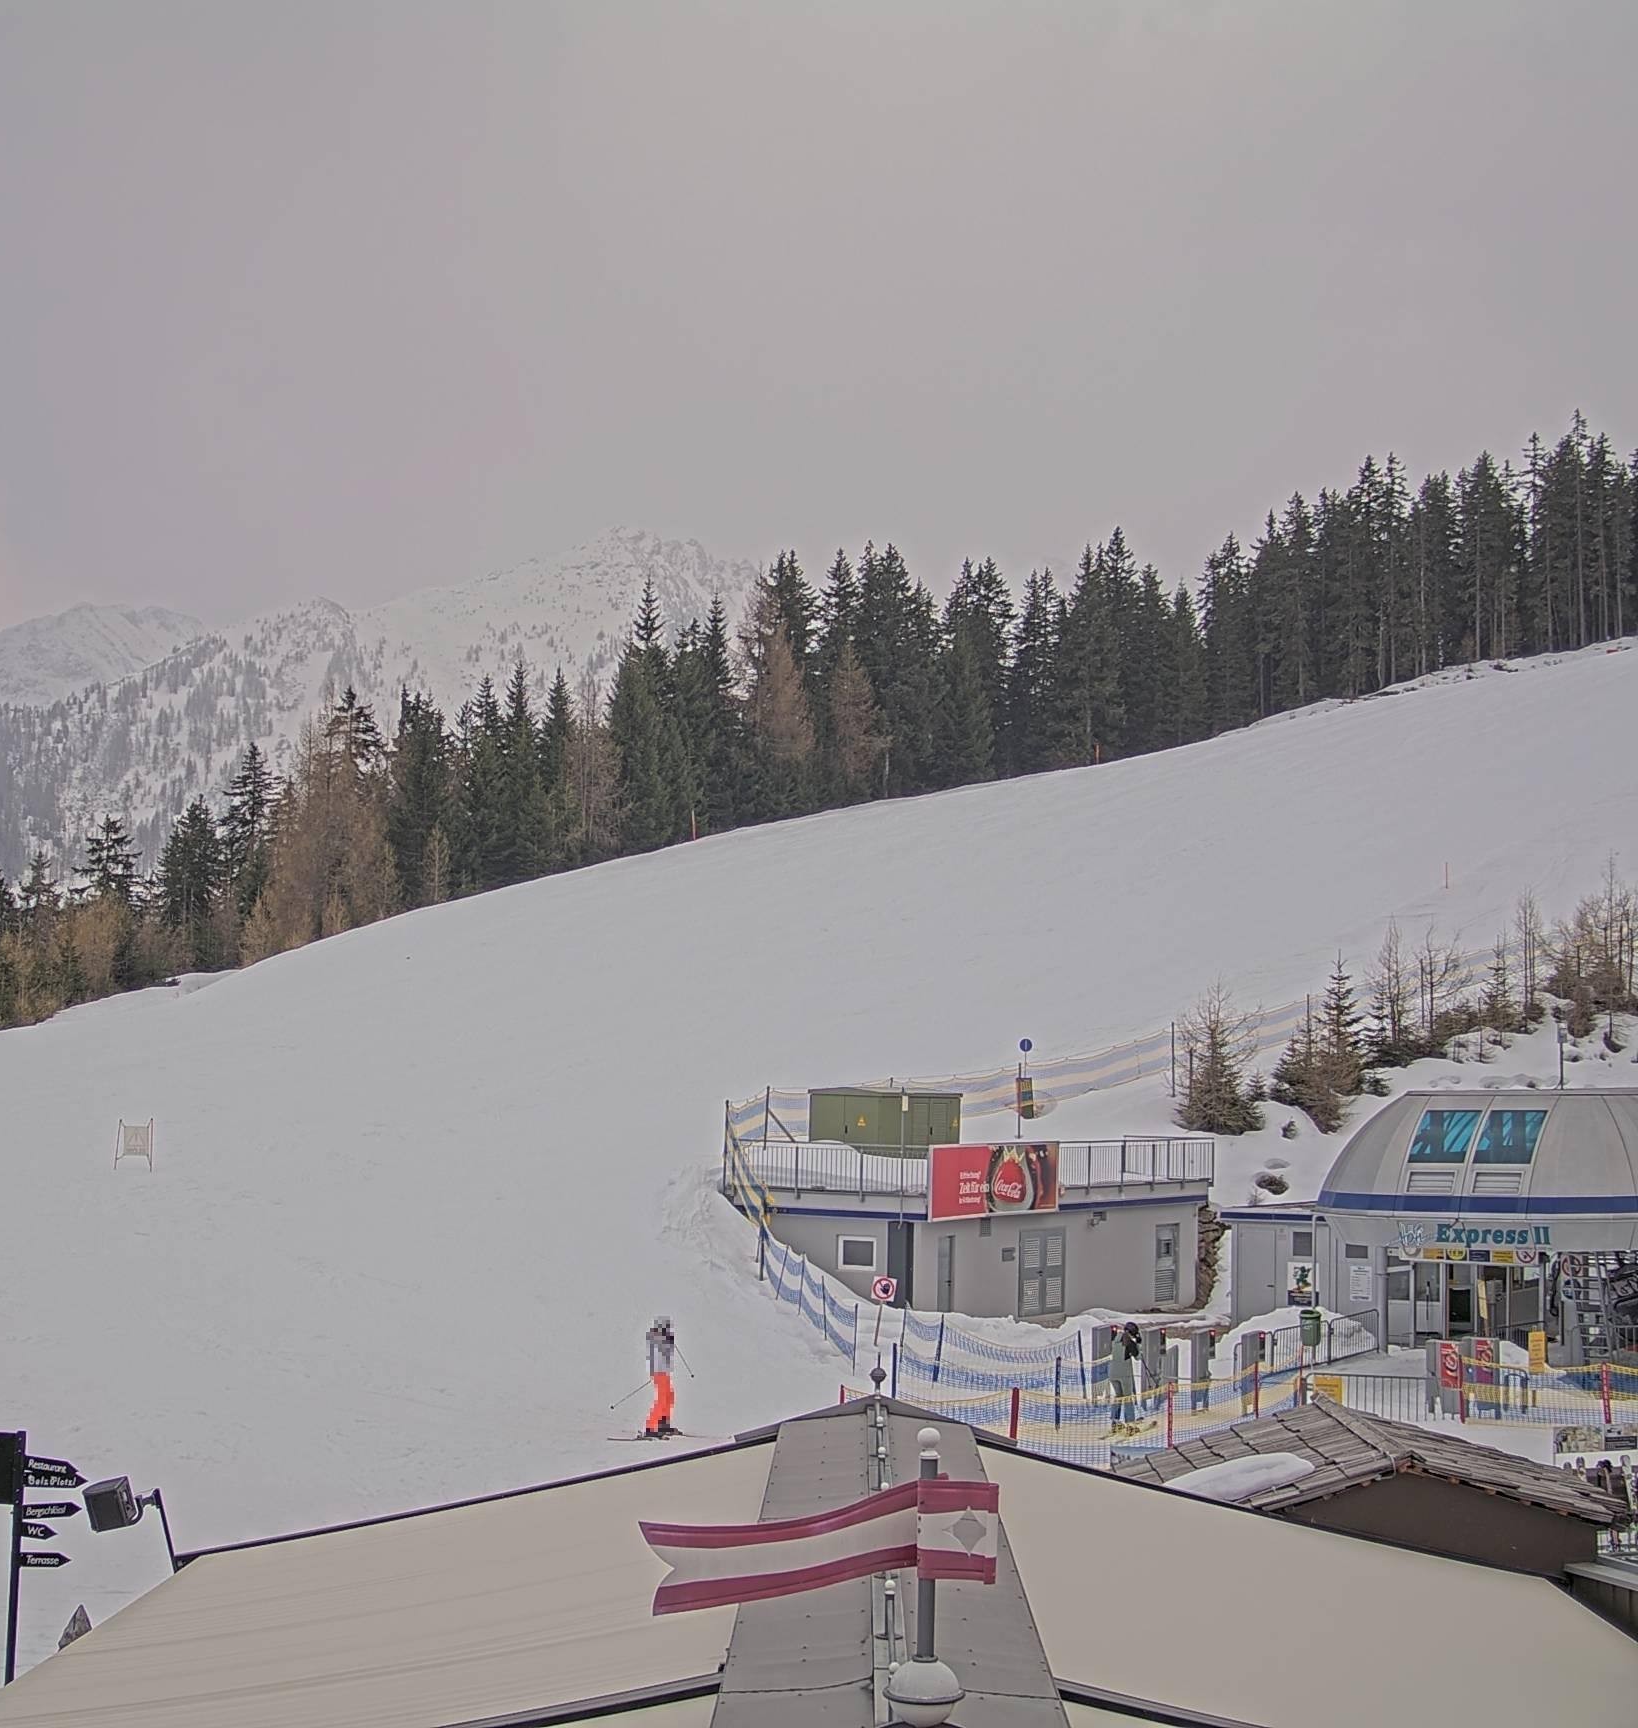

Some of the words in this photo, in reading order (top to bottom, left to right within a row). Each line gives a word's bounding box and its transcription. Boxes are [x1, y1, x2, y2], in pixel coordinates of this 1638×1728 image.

[1436, 1223, 1529, 1248] Express
[1533, 1226, 1551, 1245] II
[27, 1459, 68, 1474] Restaurant
[27, 1525, 46, 1537] WC
[26, 1554, 60, 1566] Terrasse
